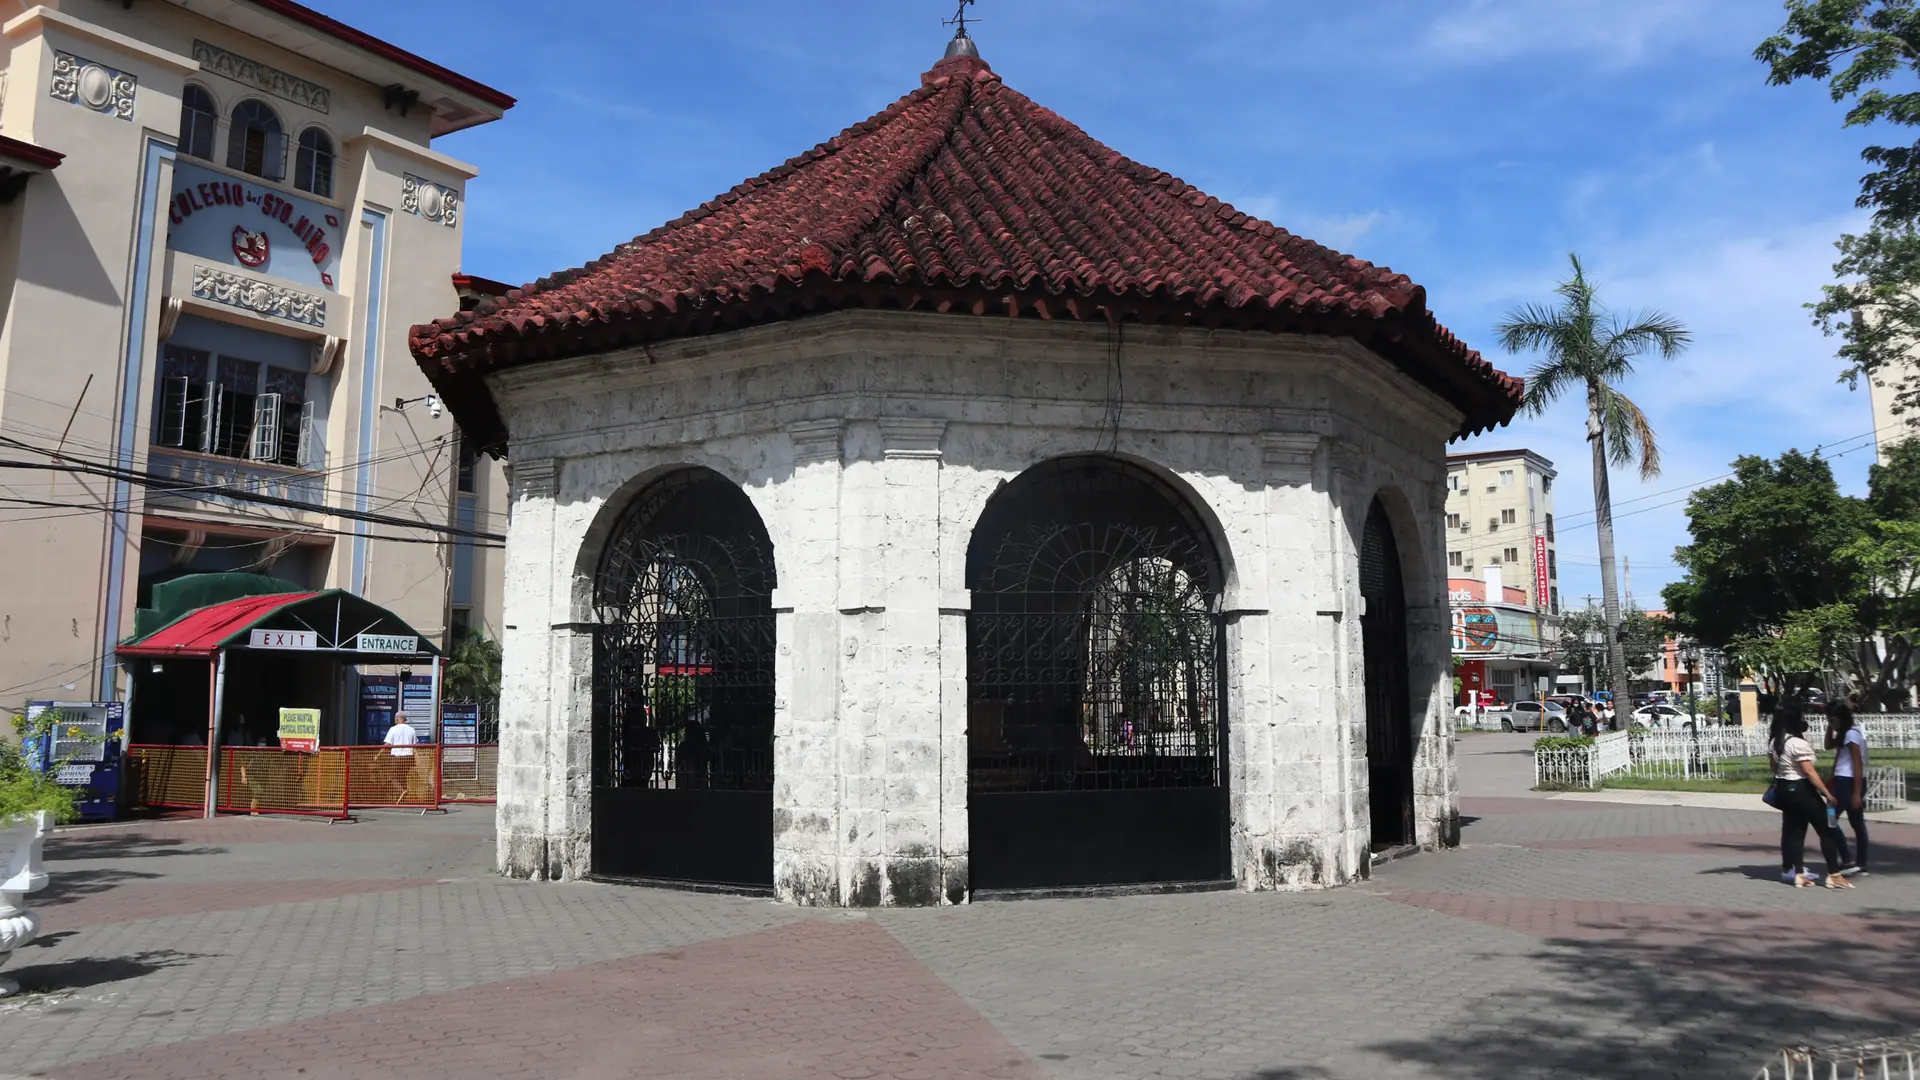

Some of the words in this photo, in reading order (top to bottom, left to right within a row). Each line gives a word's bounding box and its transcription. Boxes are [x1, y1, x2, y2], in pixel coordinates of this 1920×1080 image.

[169, 182, 244, 225] COLEGIO
[1537, 538, 1545, 579] SAMPAGUITA
[263, 633, 305, 646] EXIT
[361, 637, 414, 651] ENTRANCE
